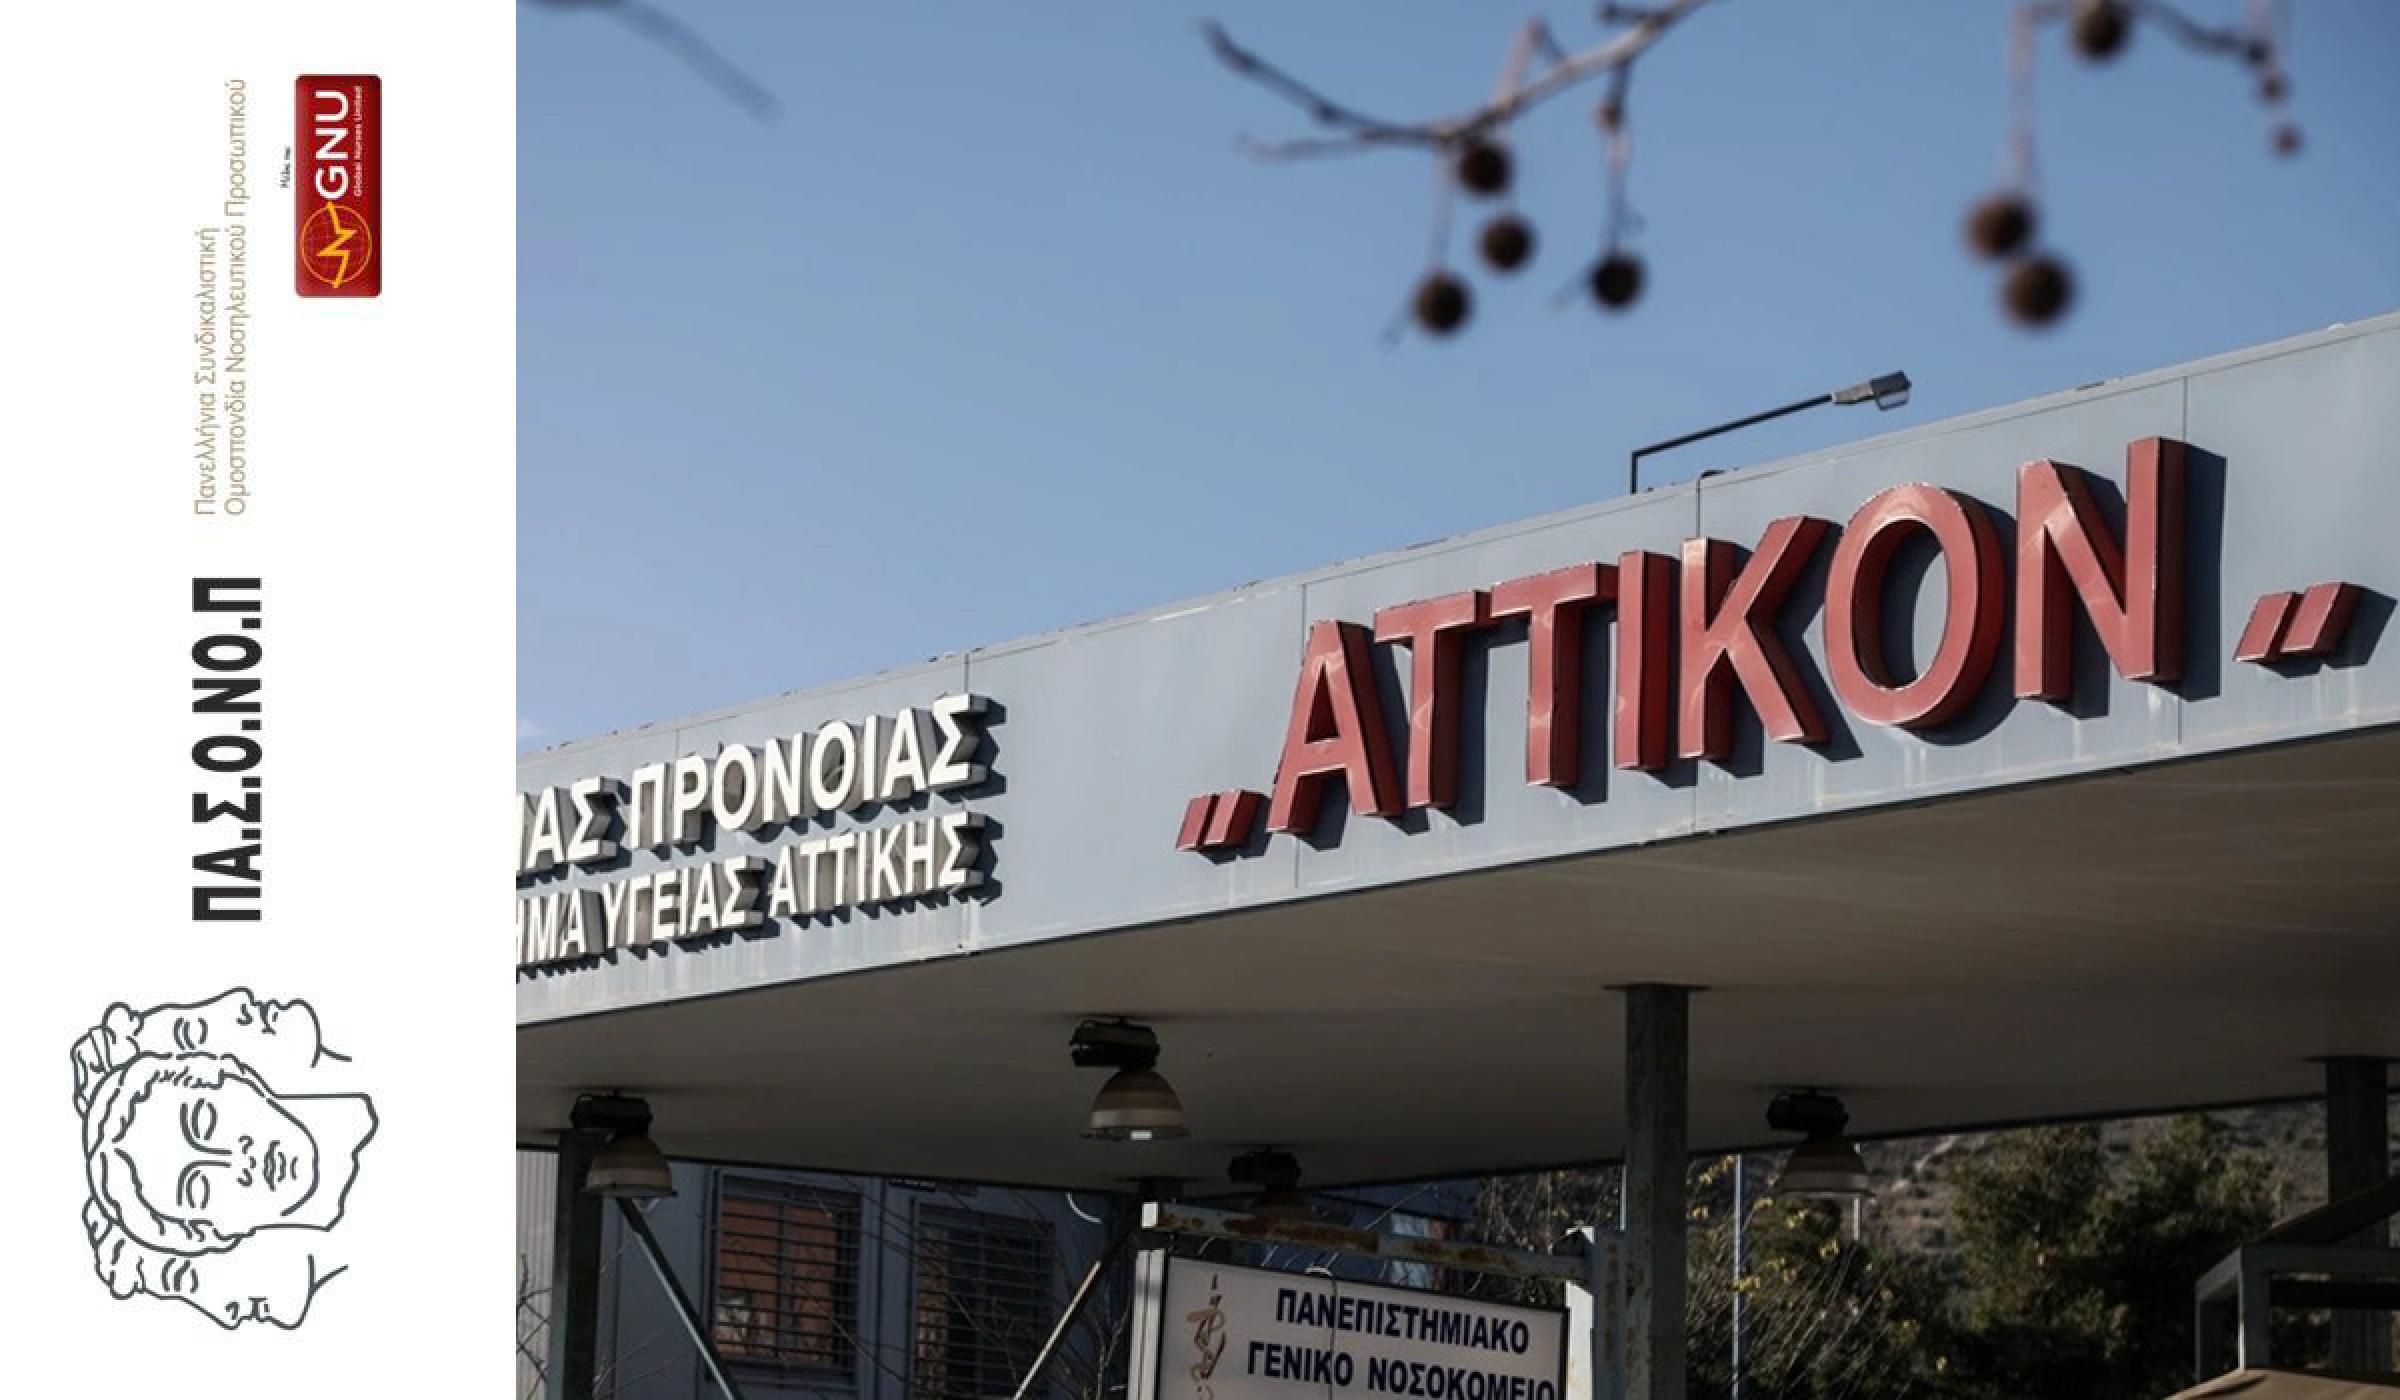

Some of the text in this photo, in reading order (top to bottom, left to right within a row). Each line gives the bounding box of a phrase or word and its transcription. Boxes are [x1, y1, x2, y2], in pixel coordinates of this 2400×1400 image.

[631, 693, 984, 850] ΠΡΟΝΟΙΑΣ
[603, 856, 760, 950] ΥΓΕΙΑΣ
[769, 812, 983, 918] ΑΤΤΙΚΗΣ
[1247, 1341, 1355, 1387] ΓΕΝΙΚΟ
[1276, 1287, 1530, 1355] ΠΑΝΕΠΙΣΤΗΜΙΑΚΟ
